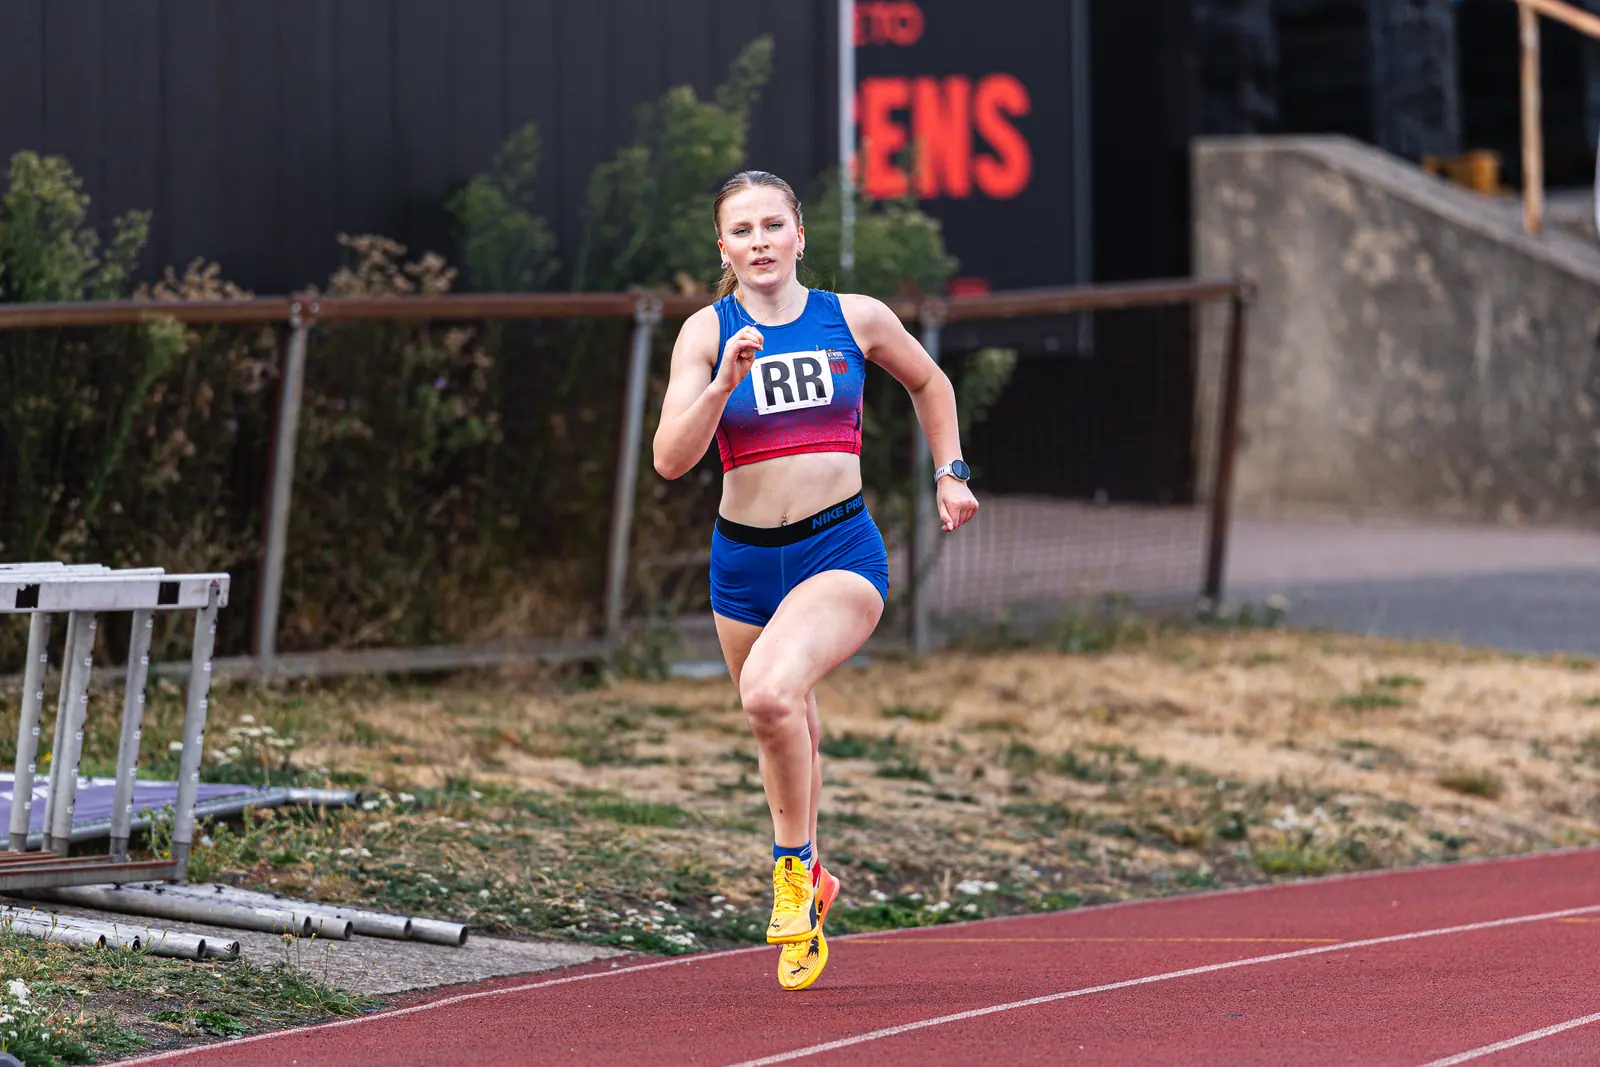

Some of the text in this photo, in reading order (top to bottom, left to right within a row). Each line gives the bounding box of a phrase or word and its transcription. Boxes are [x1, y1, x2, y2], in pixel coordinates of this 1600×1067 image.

[854, 73, 1031, 198] ENS
[760, 357, 827, 406] RR
[812, 495, 863, 529] NIKE PRO
